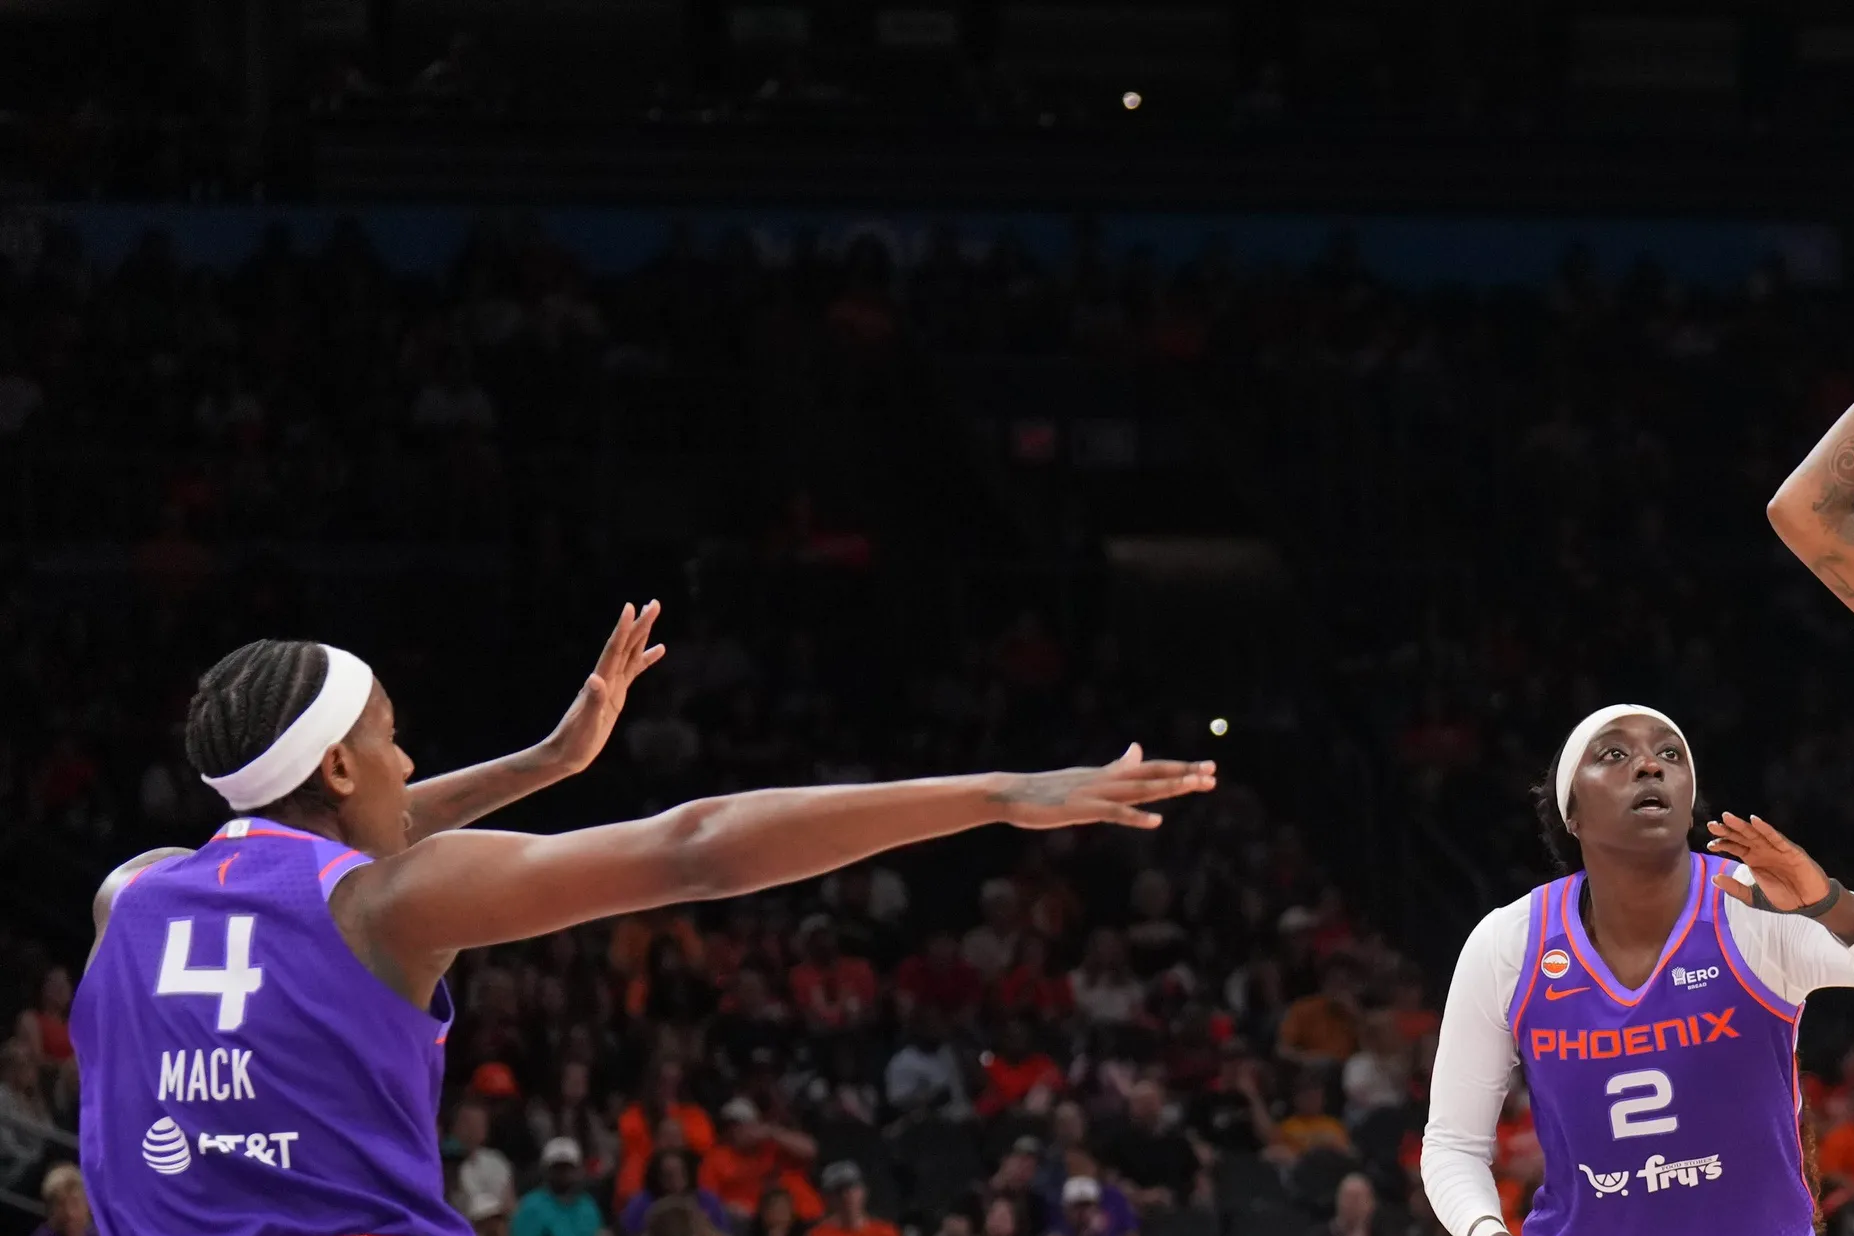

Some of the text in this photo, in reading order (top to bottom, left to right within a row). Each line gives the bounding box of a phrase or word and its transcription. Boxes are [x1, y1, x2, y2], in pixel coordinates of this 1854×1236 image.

[156, 914, 265, 1032] 4
[1671, 966, 1720, 986] HERO
[1530, 1007, 1741, 1061] PHOENIX
[158, 1047, 256, 1103] MACK
[1604, 1067, 1679, 1141] 2
[1636, 1154, 1722, 1193] fry's
[1661, 1157, 1713, 1171] FOOD STORES
